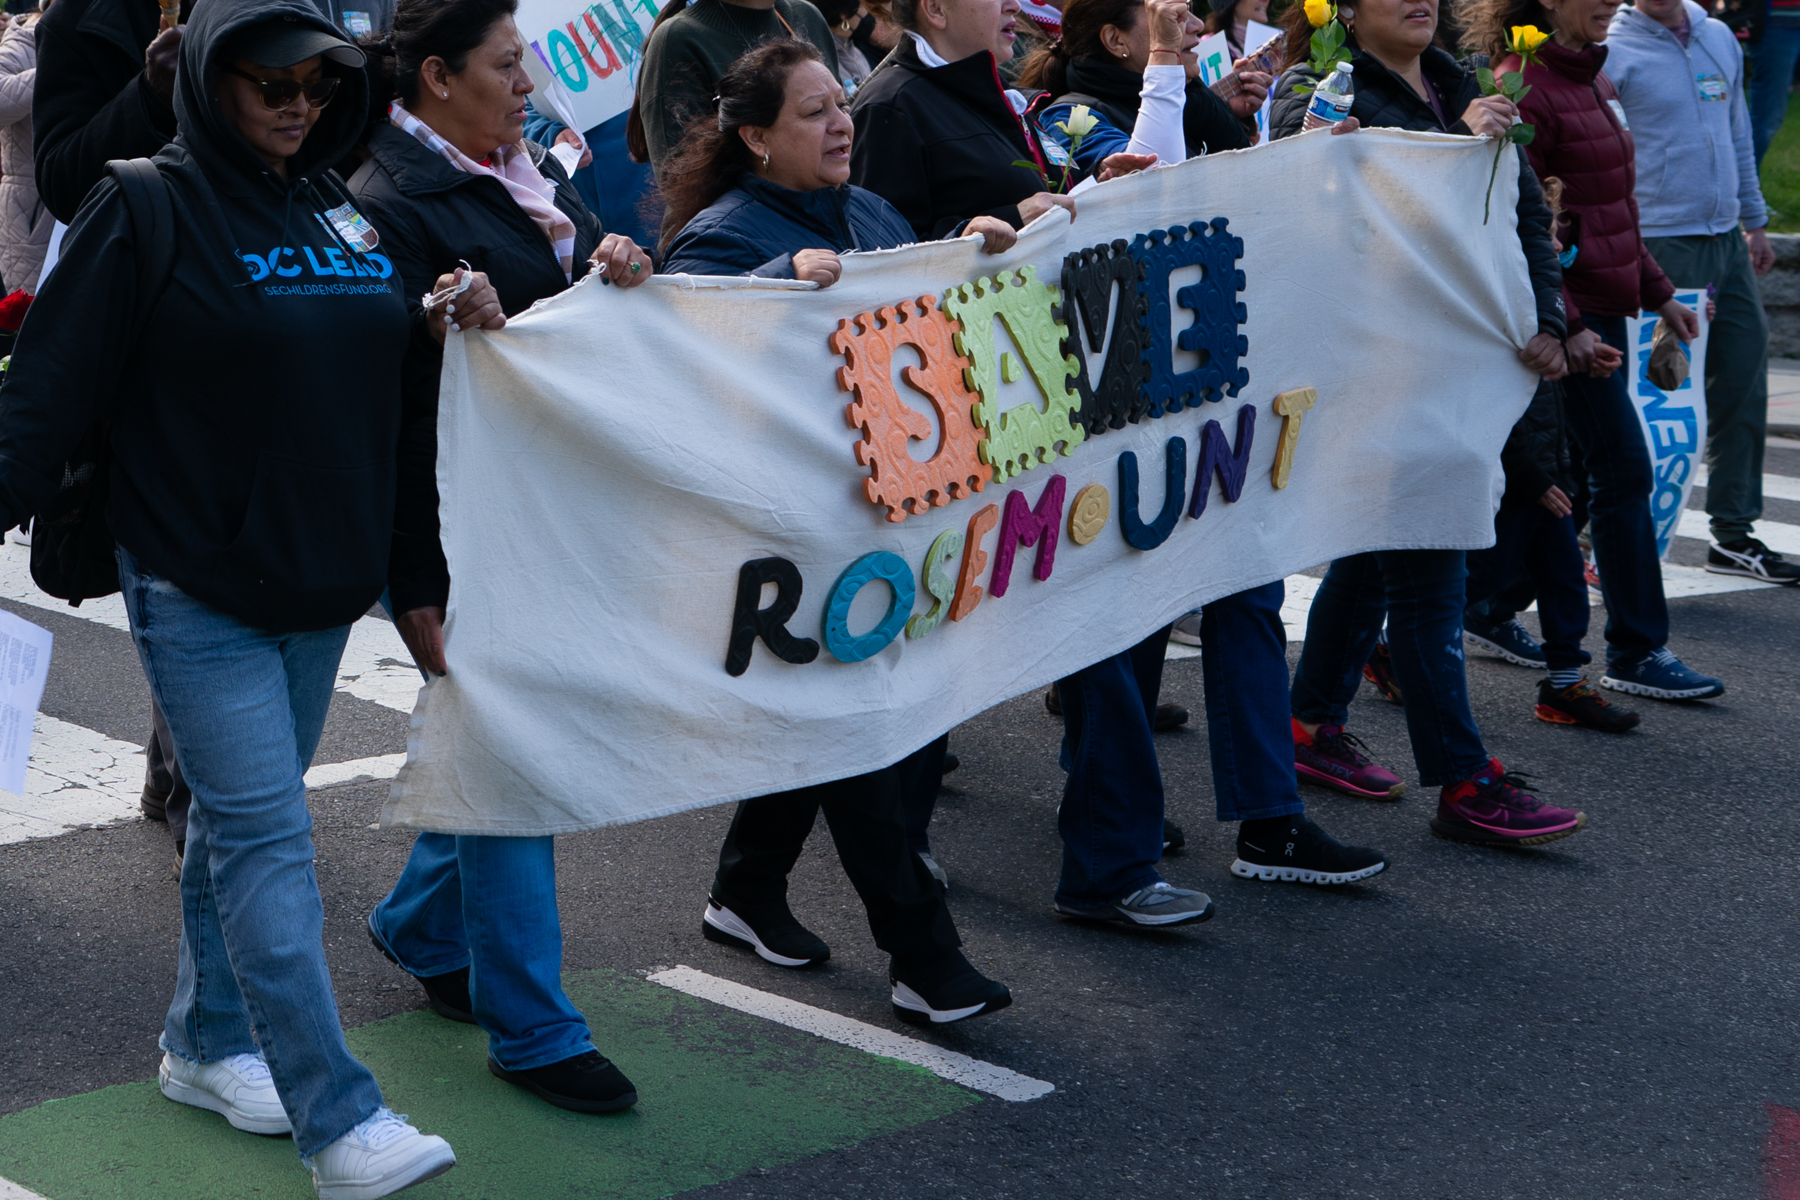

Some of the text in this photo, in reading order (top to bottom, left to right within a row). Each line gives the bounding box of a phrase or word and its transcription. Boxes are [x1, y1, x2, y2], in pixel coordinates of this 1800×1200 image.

[243, 246, 393, 282] DC LEAD
[264, 283, 392, 296] SECHILDRENSFUND.ORG
[838, 228, 1242, 511] SAVE
[725, 385, 1317, 677] ROSEMOUNT
